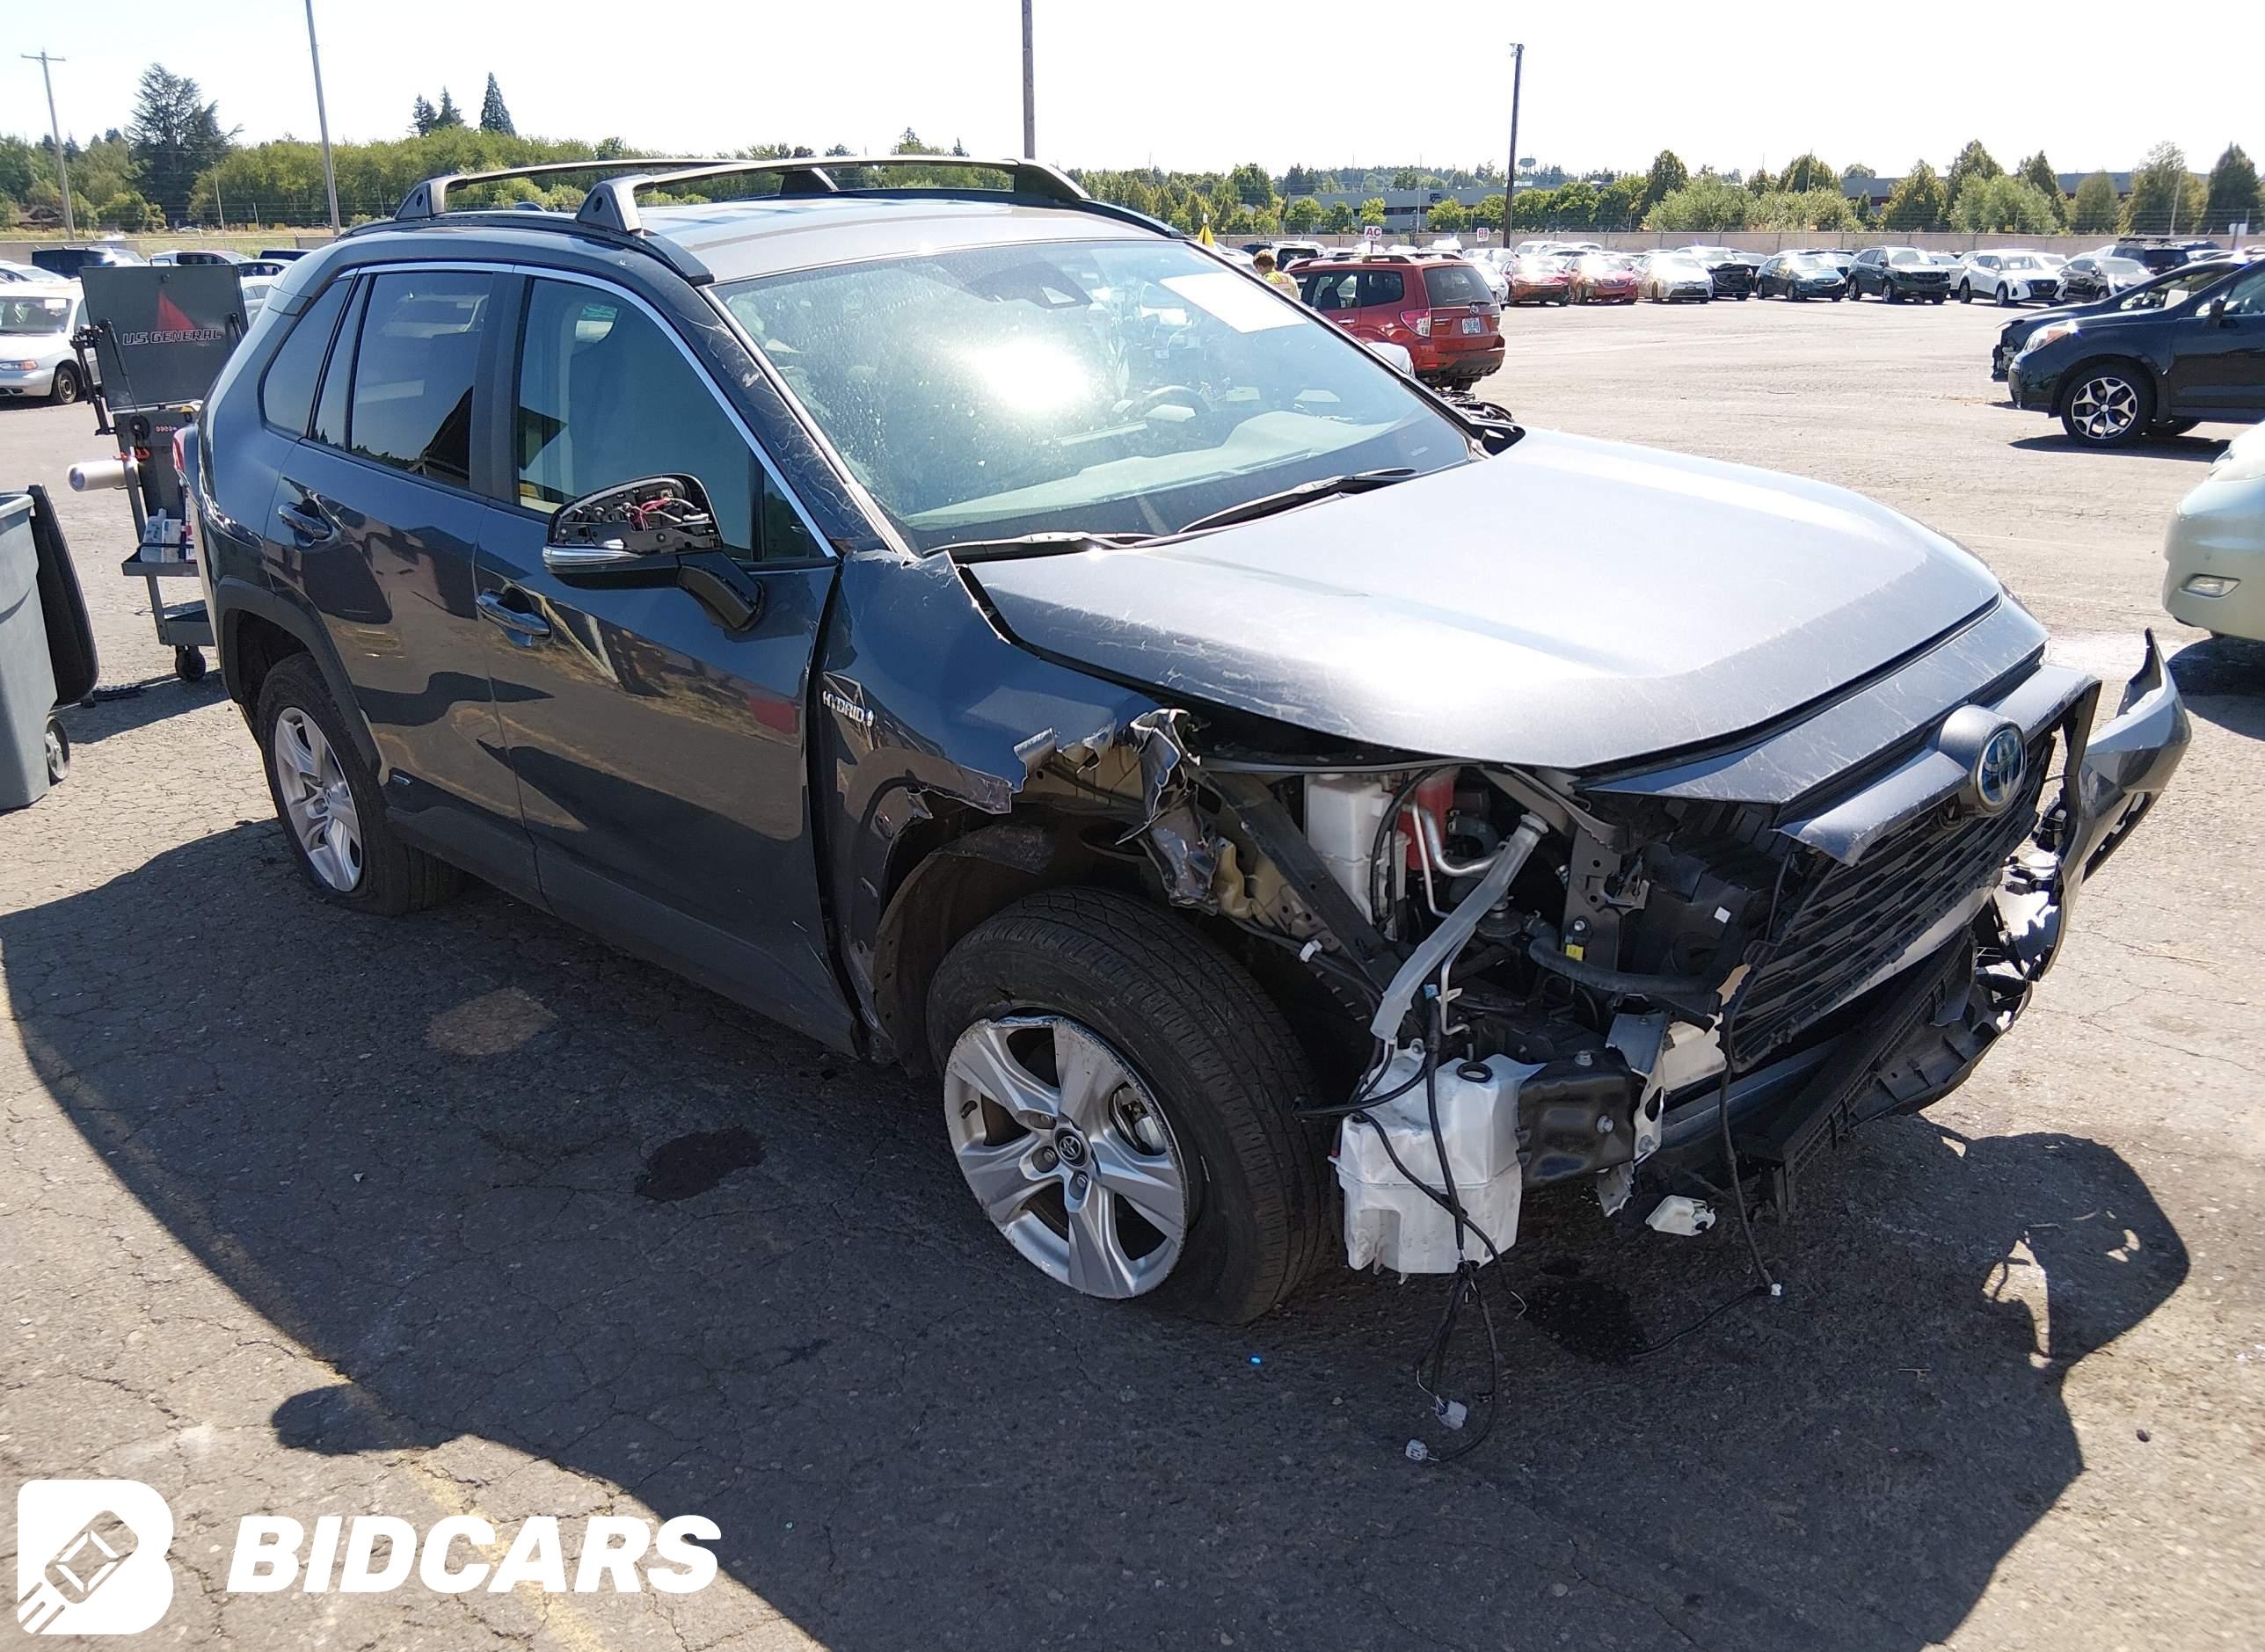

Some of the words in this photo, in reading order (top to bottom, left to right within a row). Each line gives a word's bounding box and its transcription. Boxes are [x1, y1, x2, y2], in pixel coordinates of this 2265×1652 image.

[1366, 227, 1380, 237] AC
[150, 329, 221, 343] GENERAL
[823, 690, 865, 723] HYBRID
